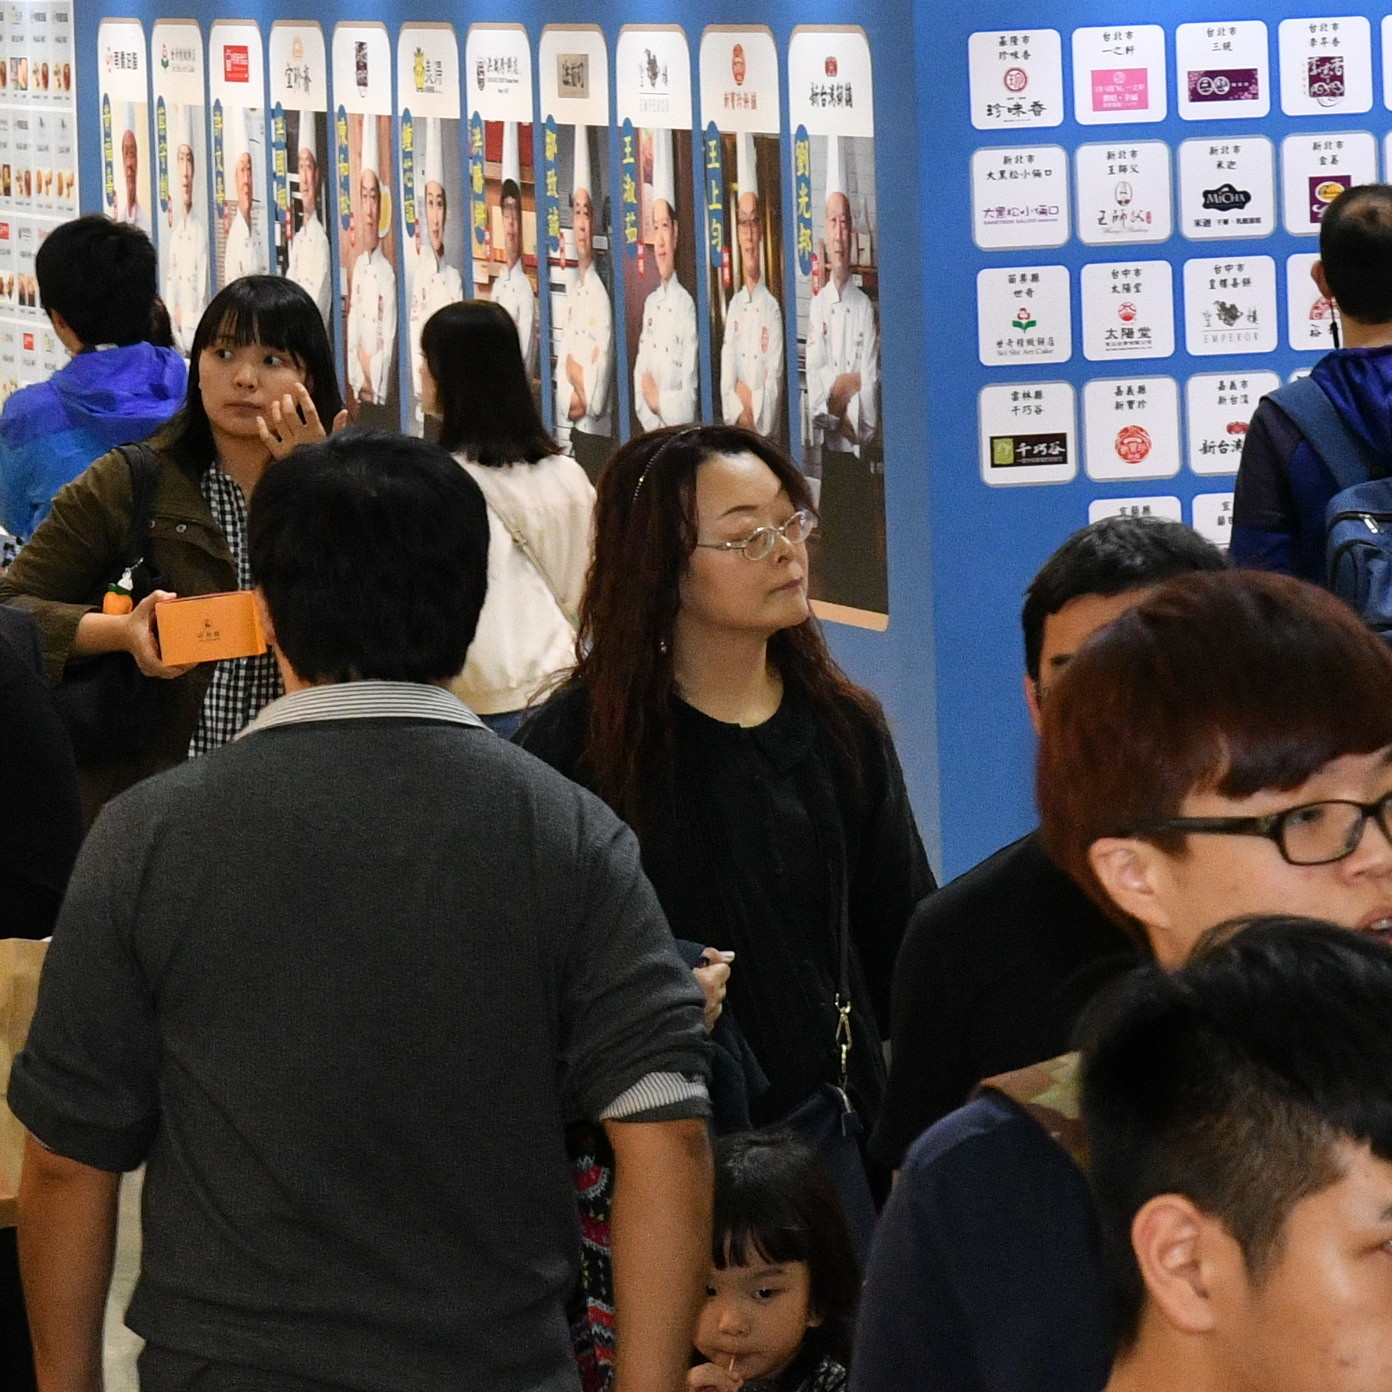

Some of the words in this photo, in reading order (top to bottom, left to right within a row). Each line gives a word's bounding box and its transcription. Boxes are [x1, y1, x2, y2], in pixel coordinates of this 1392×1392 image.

[1206, 27, 1237, 38] 台北市
[1309, 22, 1341, 34] 台北市
[998, 35, 1031, 48] 基隆市
[1102, 31, 1135, 43] 台北市
[998, 50, 1032, 61] 珍味香
[986, 100, 1047, 119] 珍味香
[1209, 145, 1242, 156] 新北市
[1313, 140, 1344, 151] 新北市
[1003, 154, 1036, 166] 新北市
[1107, 149, 1139, 161] 新北市
[986, 168, 1053, 182] 大黑松小倆口
[1107, 164, 1140, 176] 王師父
[983, 205, 1060, 220] 大黑松小倆口
[1111, 268, 1143, 280] 台中市
[1213, 263, 1245, 275] 台中市
[1112, 283, 1144, 294] 太陽堂
[1105, 327, 1153, 340] 太陽堂
[1114, 385, 1147, 397] 嘉義縣
[1217, 379, 1249, 391] 嘉義市
[1011, 405, 1045, 417] 千巧谷
[1015, 441, 1067, 458] 千巧谷
